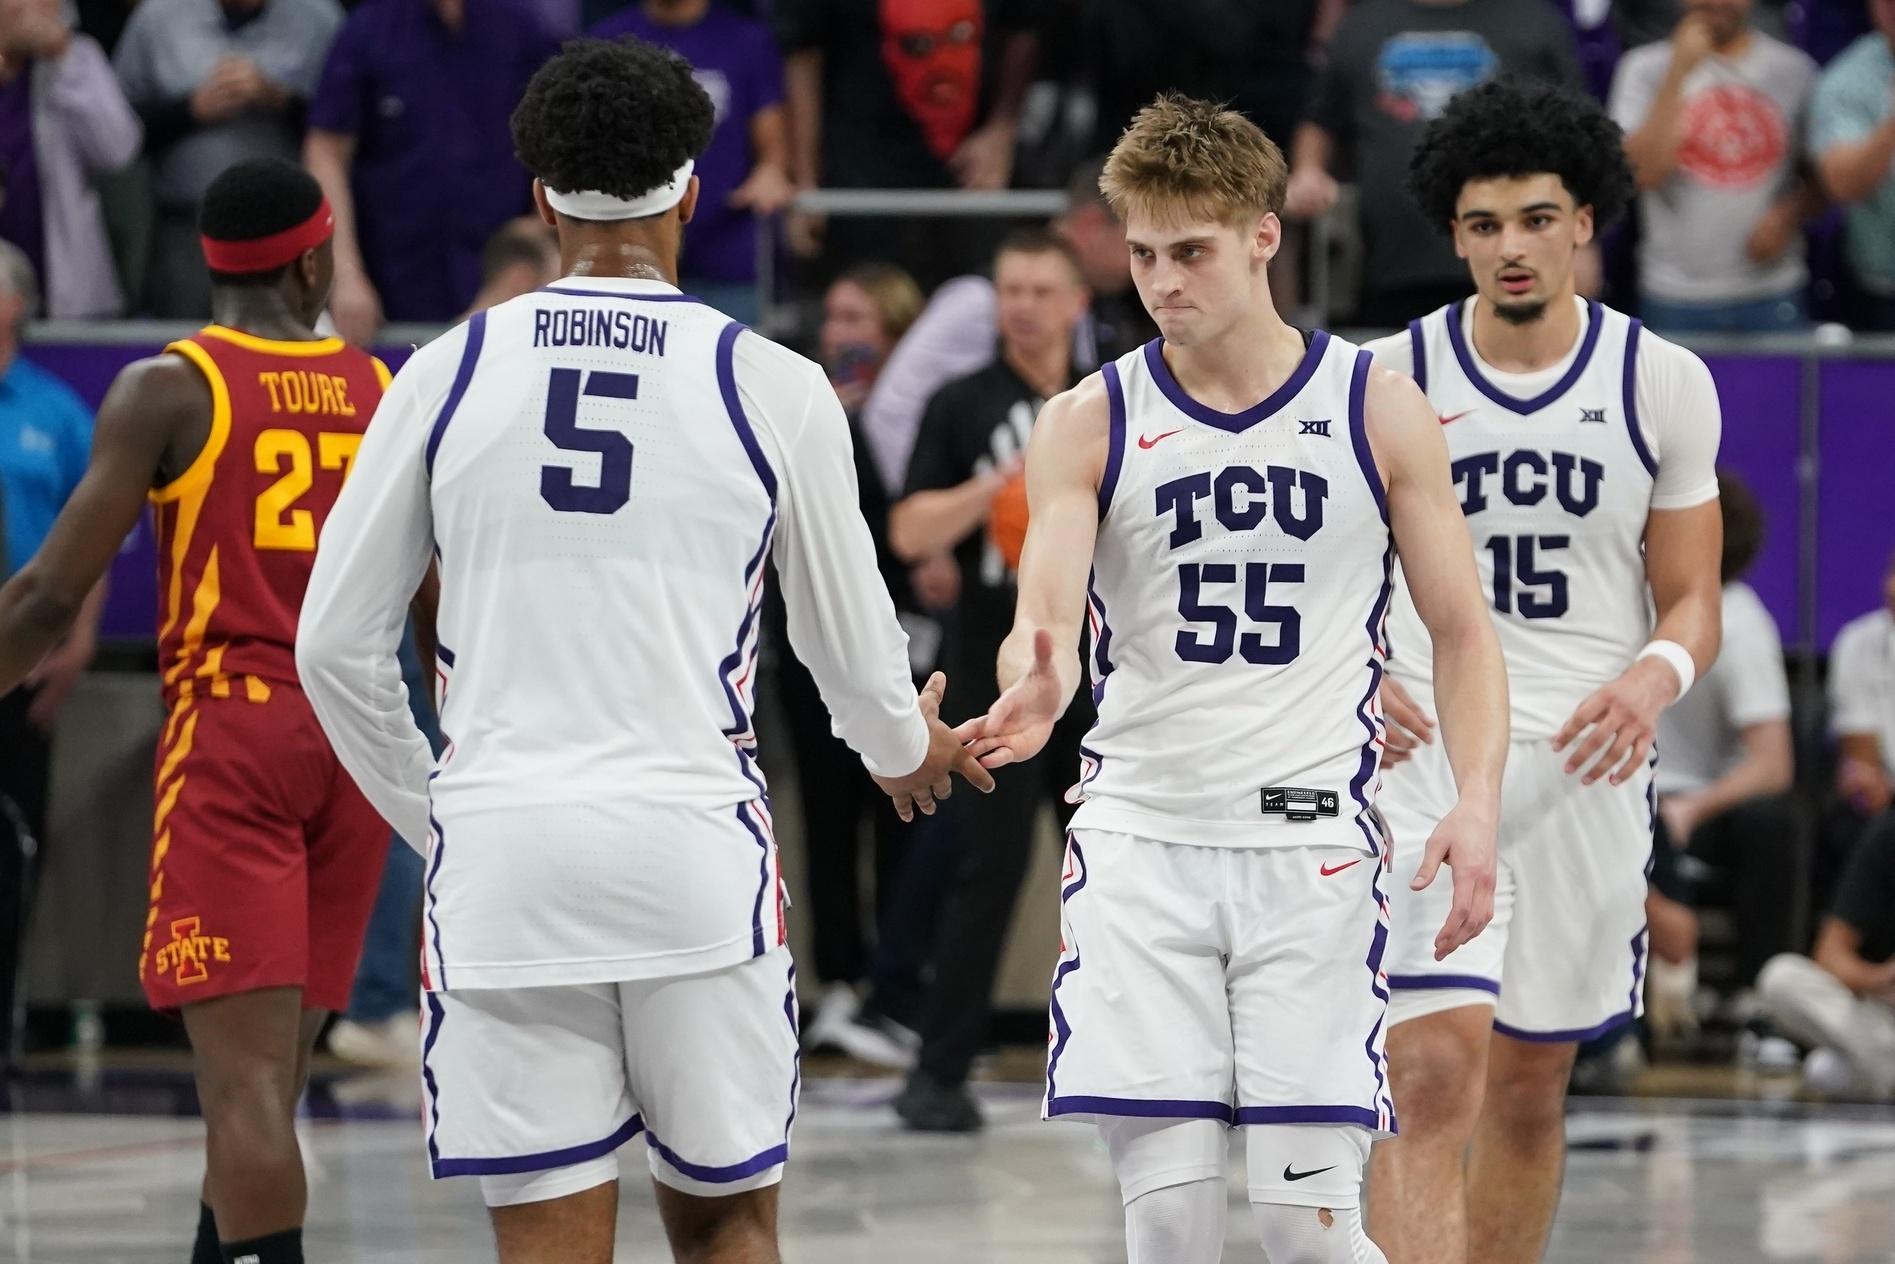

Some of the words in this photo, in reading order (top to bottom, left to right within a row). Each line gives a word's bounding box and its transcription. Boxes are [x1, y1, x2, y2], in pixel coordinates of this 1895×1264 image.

[533, 309, 667, 357] ROBINSON
[259, 371, 357, 416] TOURE
[1579, 407, 1608, 423] XII
[540, 367, 639, 515] 5
[1298, 419, 1332, 438] XII
[1451, 448, 1604, 518] TCU
[1155, 465, 1329, 550] TCU
[1485, 535, 1570, 619] 15
[1174, 562, 1305, 666] 55
[1321, 797, 1335, 808] 46
[156, 936, 231, 975] STATE
